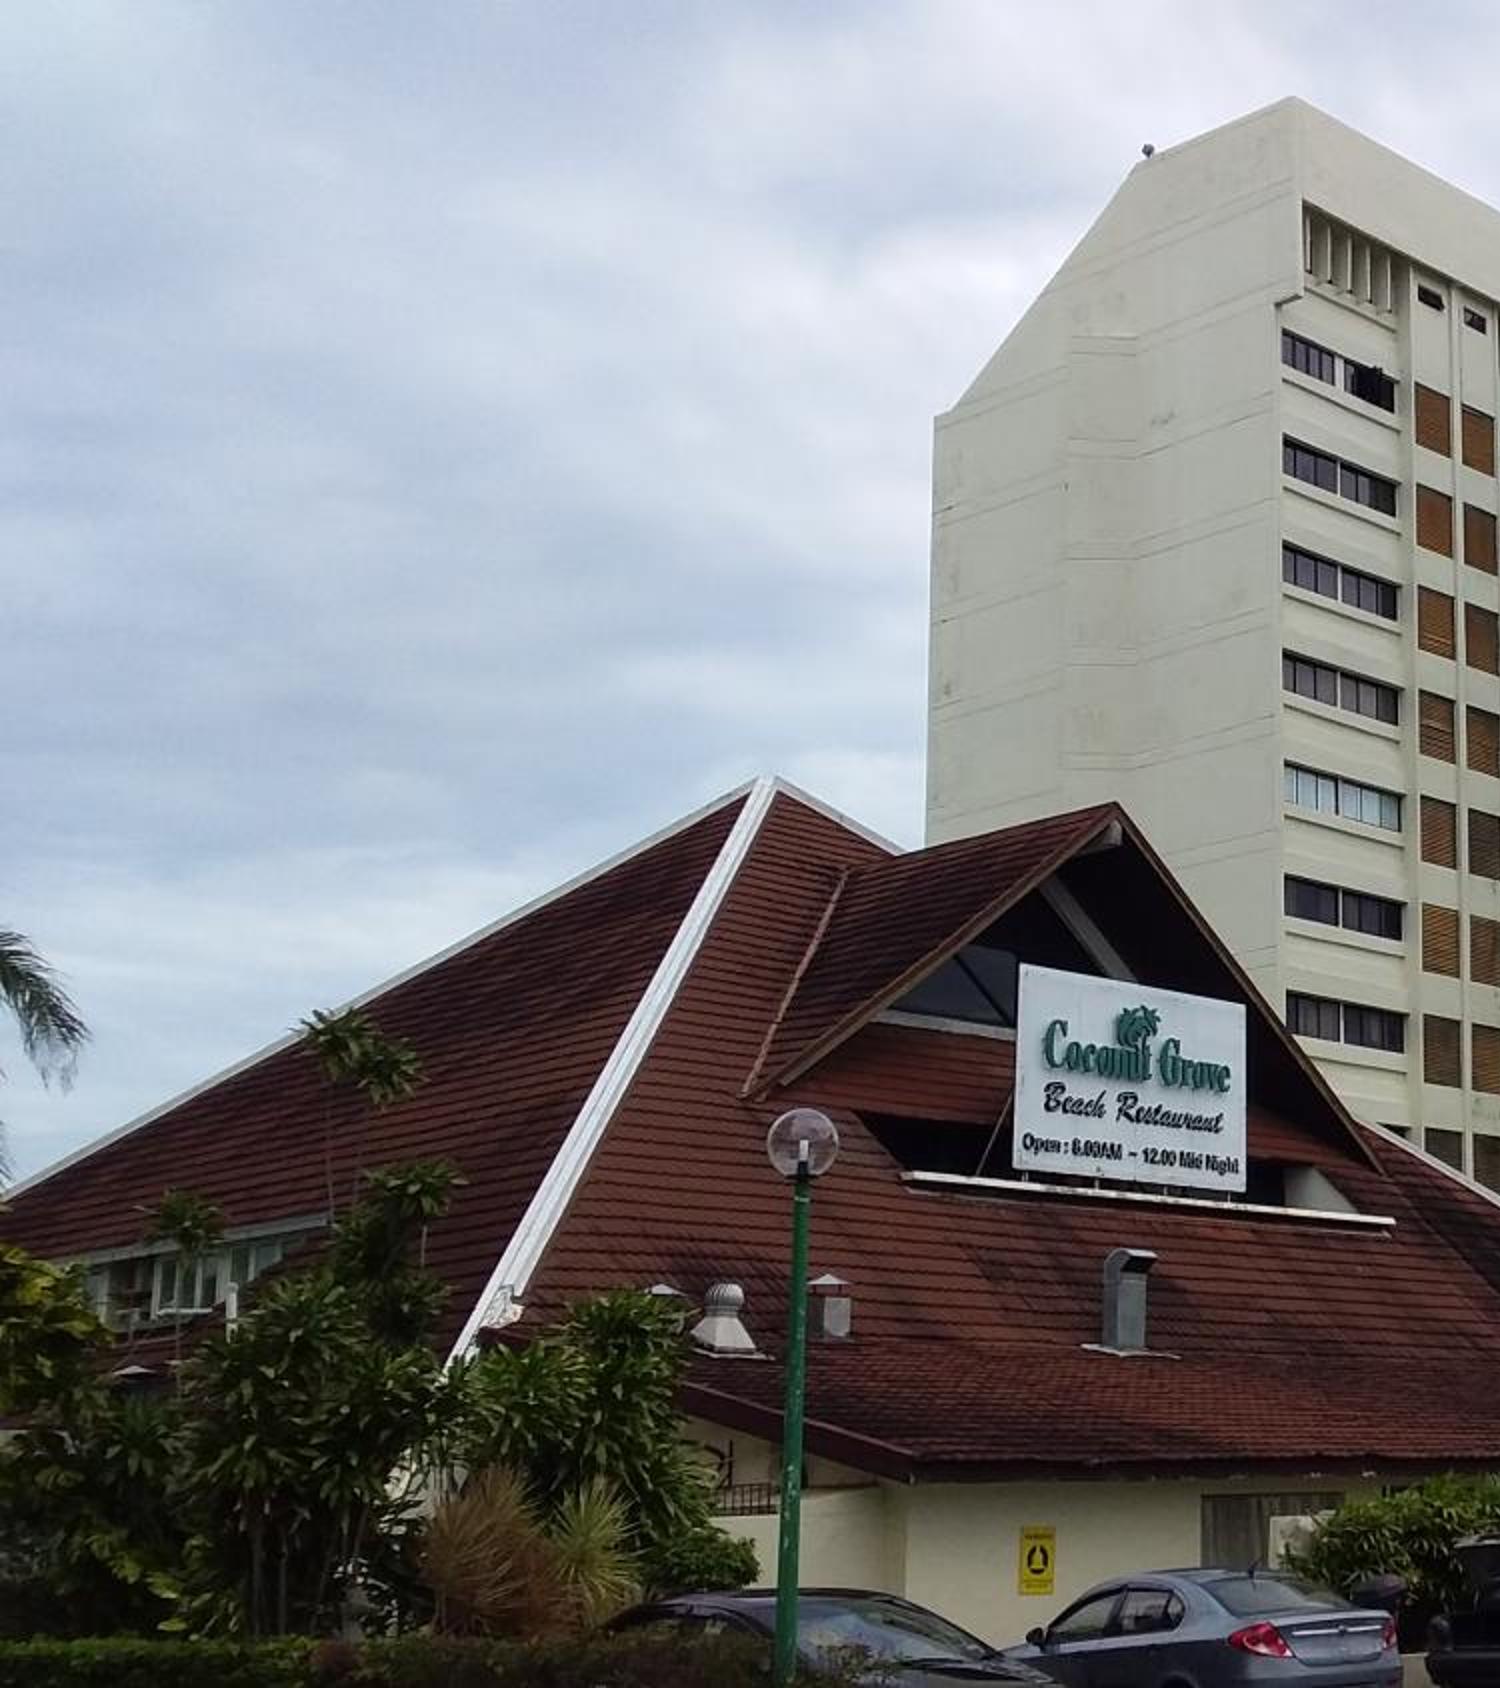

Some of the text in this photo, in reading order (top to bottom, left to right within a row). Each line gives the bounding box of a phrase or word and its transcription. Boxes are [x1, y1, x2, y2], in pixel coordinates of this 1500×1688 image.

[1043, 1019, 1231, 1092] Coconut Grove
[1043, 1081, 1224, 1134] Beach Restaurant
[1141, 1146, 1177, 1167] 12.00
[1205, 1153, 1240, 1176] Night
